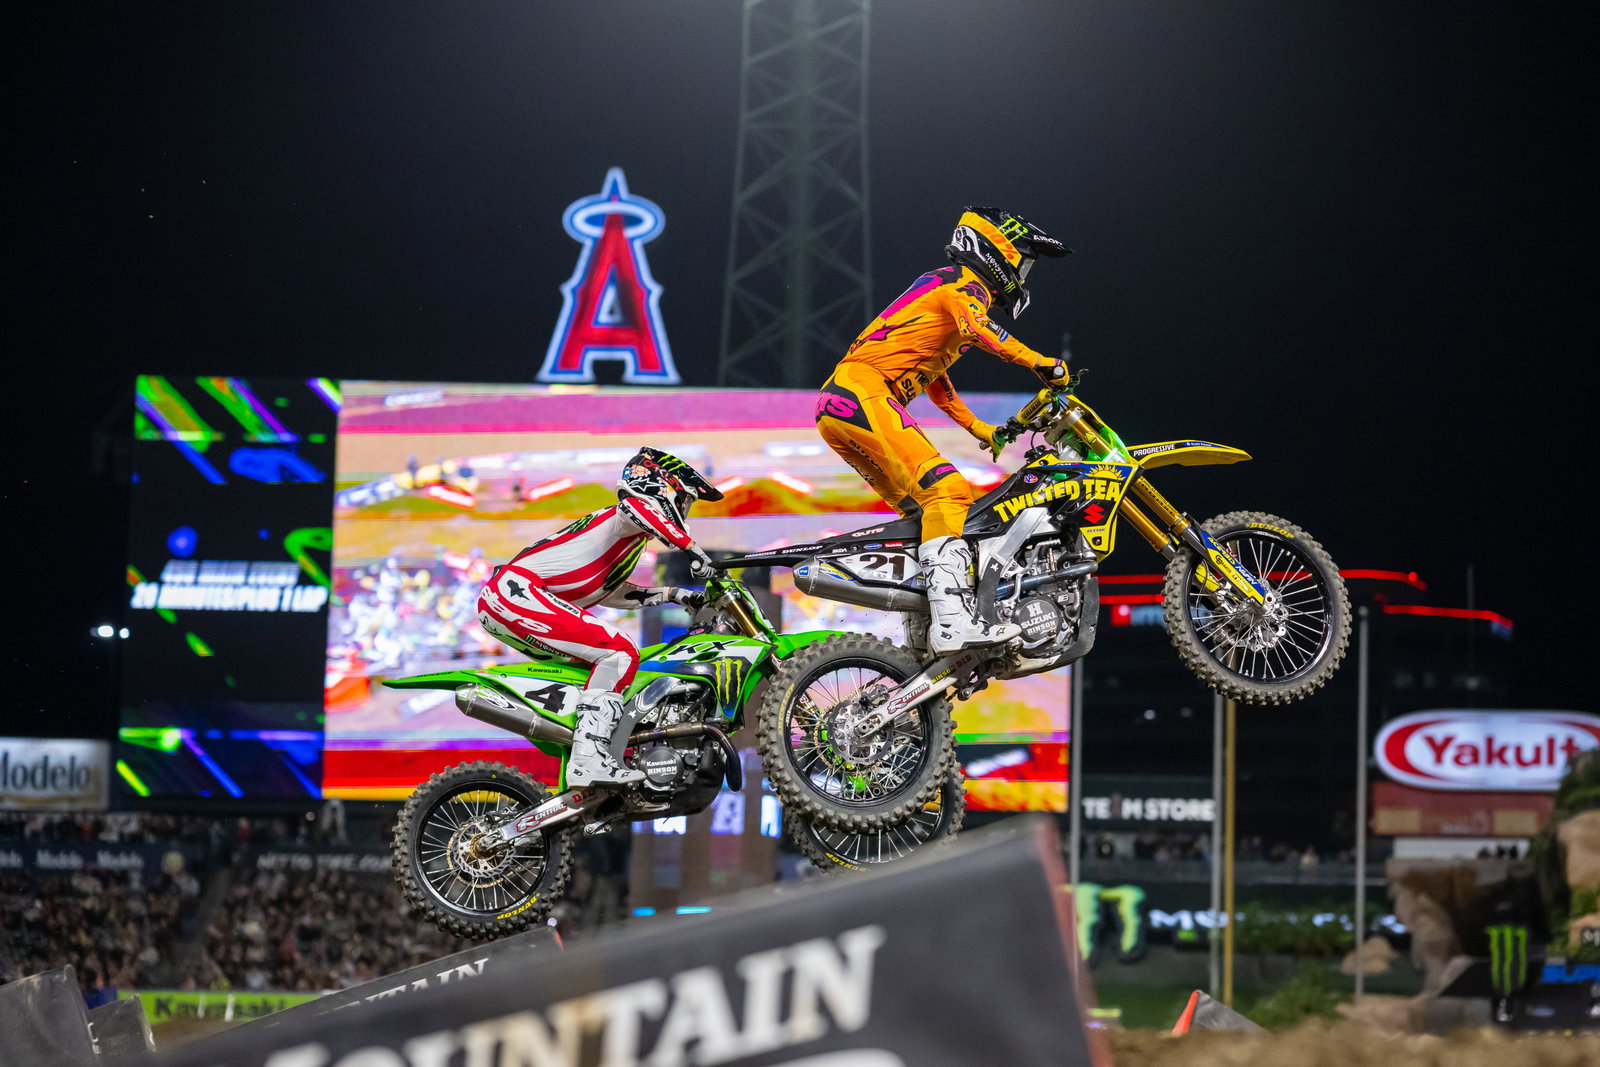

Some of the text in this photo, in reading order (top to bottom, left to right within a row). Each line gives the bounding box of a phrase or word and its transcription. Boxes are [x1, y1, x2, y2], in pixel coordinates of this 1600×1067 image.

[1133, 443, 1176, 457] PROGRESSIVE
[993, 480, 1081, 523] TWISTED
[1083, 479, 1122, 503] TEA
[1250, 522, 1295, 539] DUNLOP
[781, 545, 823, 555] DUNLOP
[859, 554, 905, 581] 21
[1020, 611, 1058, 630] SUZUKI
[1026, 621, 1056, 636] HINSON
[667, 638, 744, 656] KX
[524, 682, 569, 714] 4
[1423, 735, 1580, 768] Yakult
[646, 759, 677, 767] Kawasaki
[648, 766, 677, 775] HINSON
[1144, 798, 1216, 821] STORE
[496, 896, 538, 919] DUNLOP
